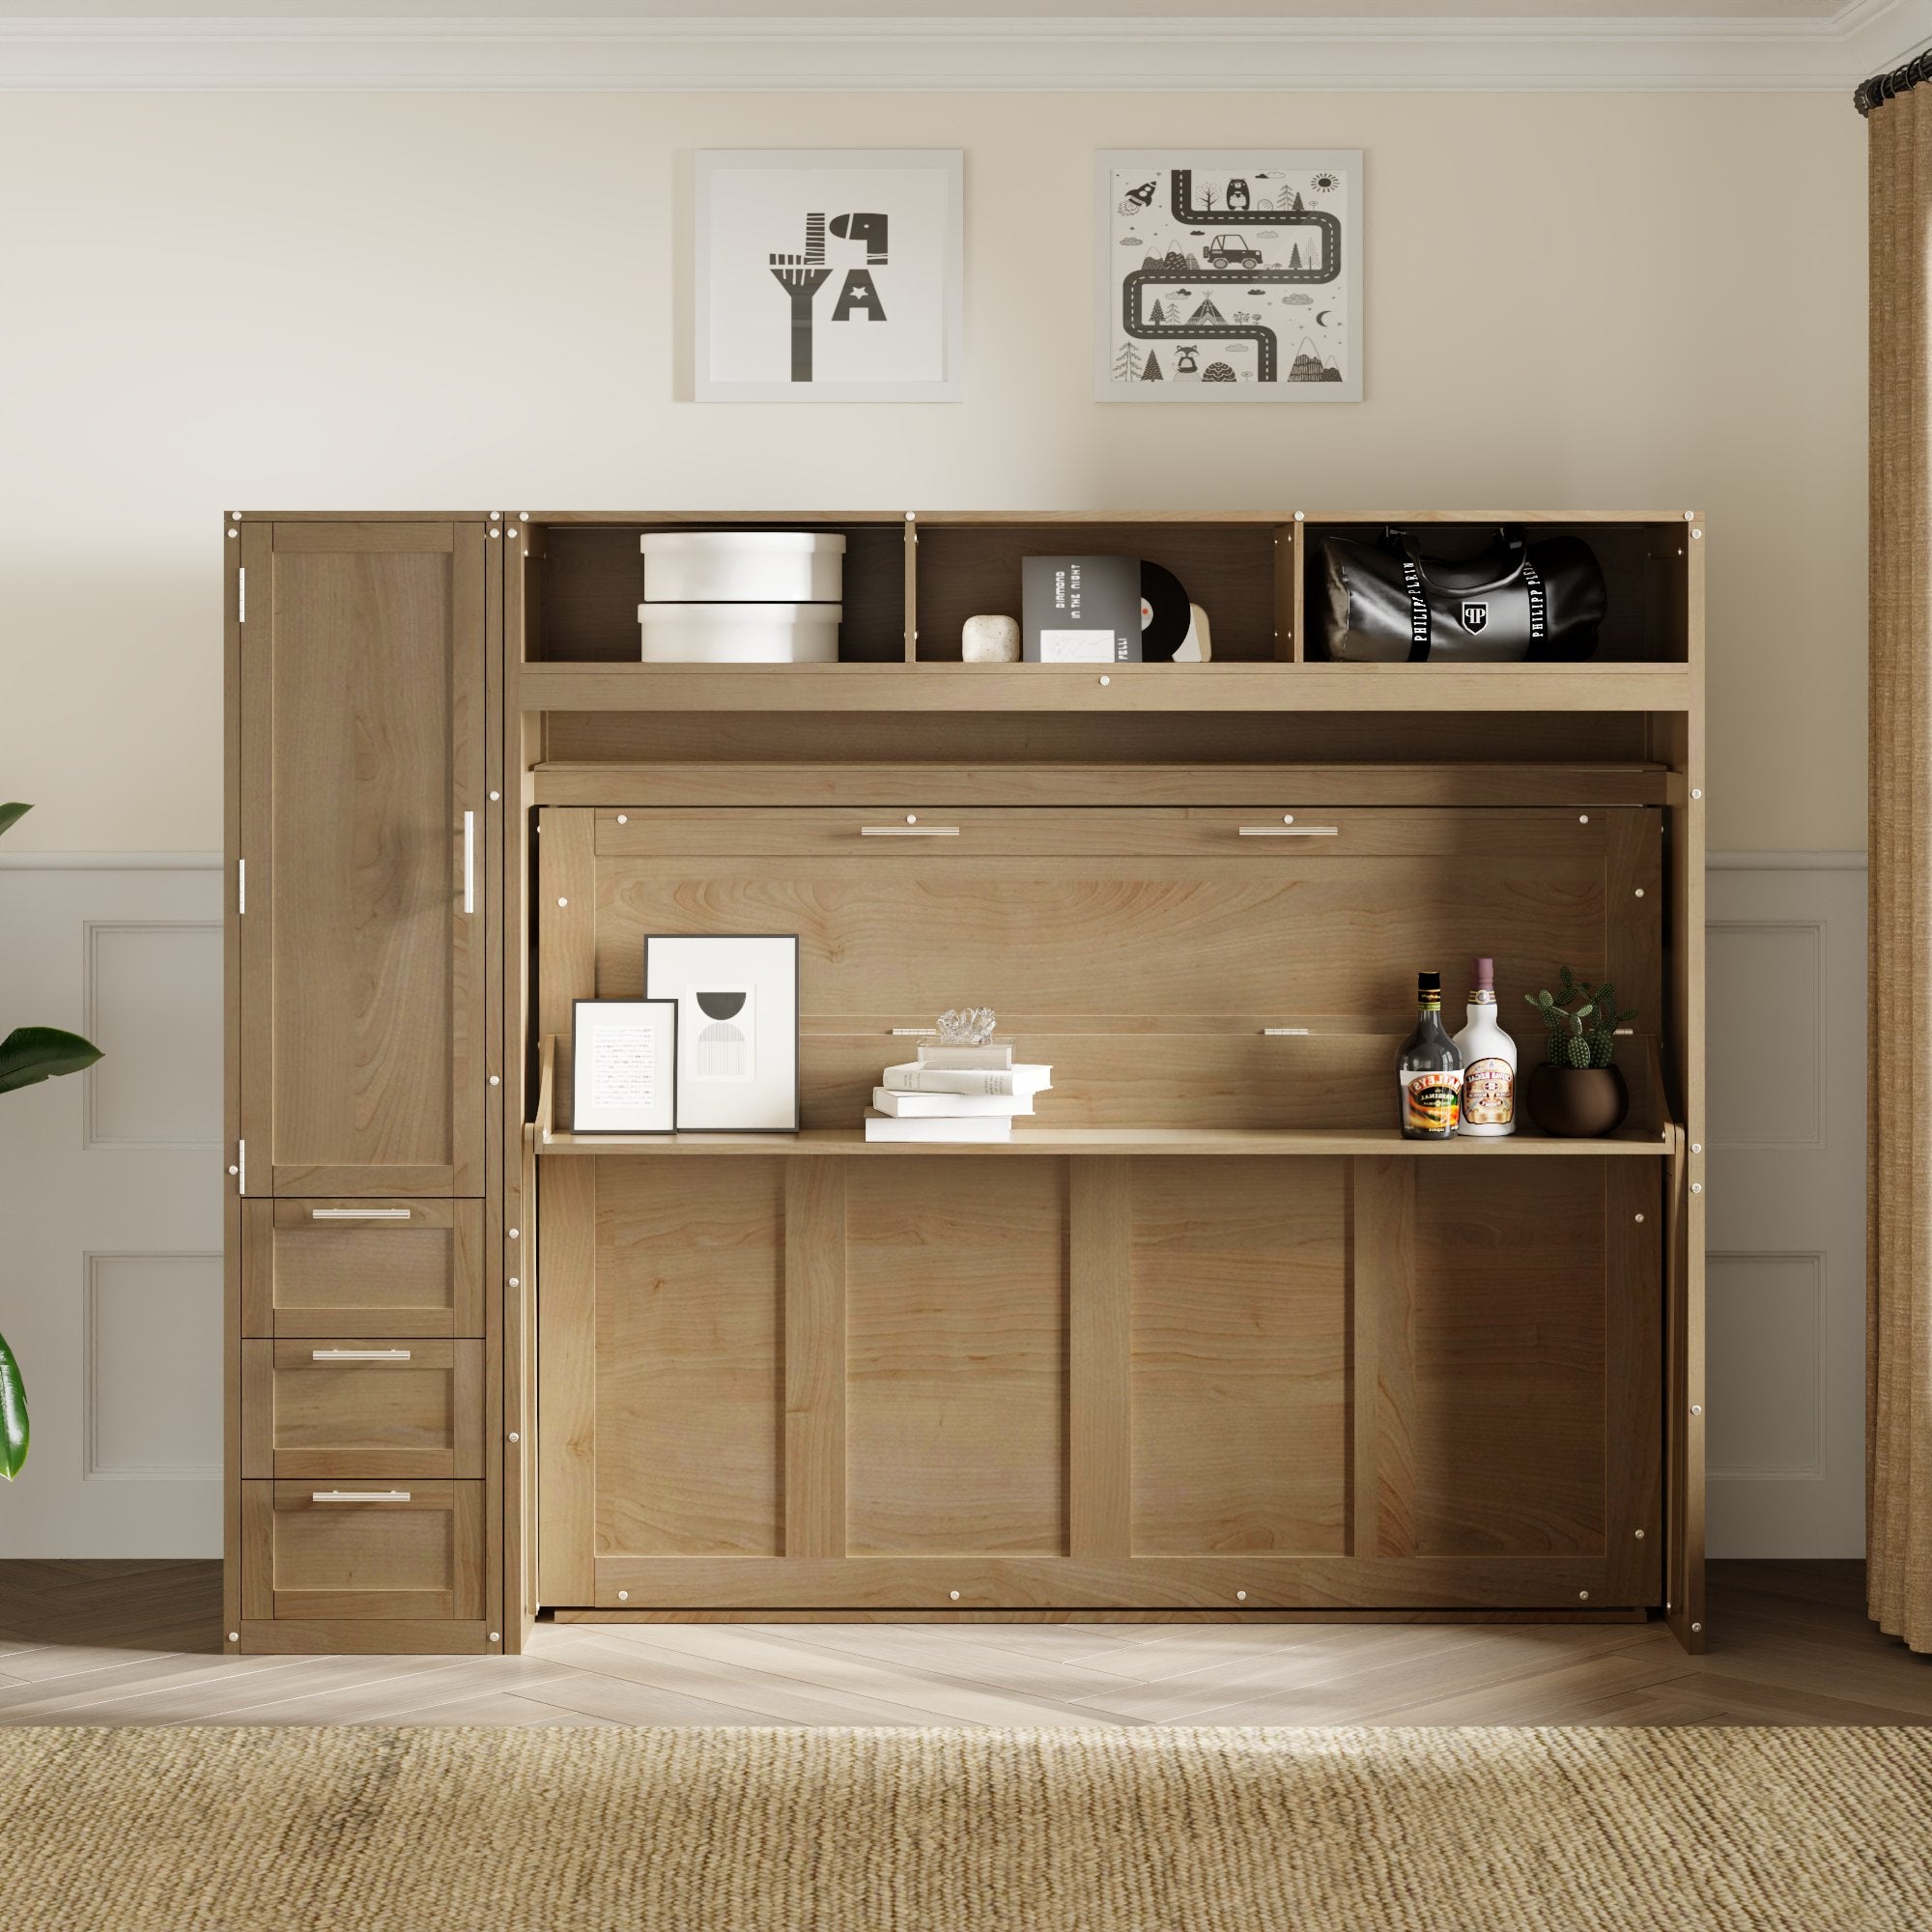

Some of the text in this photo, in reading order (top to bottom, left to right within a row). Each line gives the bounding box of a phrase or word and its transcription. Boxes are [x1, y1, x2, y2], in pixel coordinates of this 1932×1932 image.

[1055, 571, 1065, 609] DIAMOND
[1070, 564, 1081, 619] IN THE NIGHT
[1403, 562, 1428, 641] PHILIPP PLEIN
[1530, 589, 1544, 638] PHILIPP
